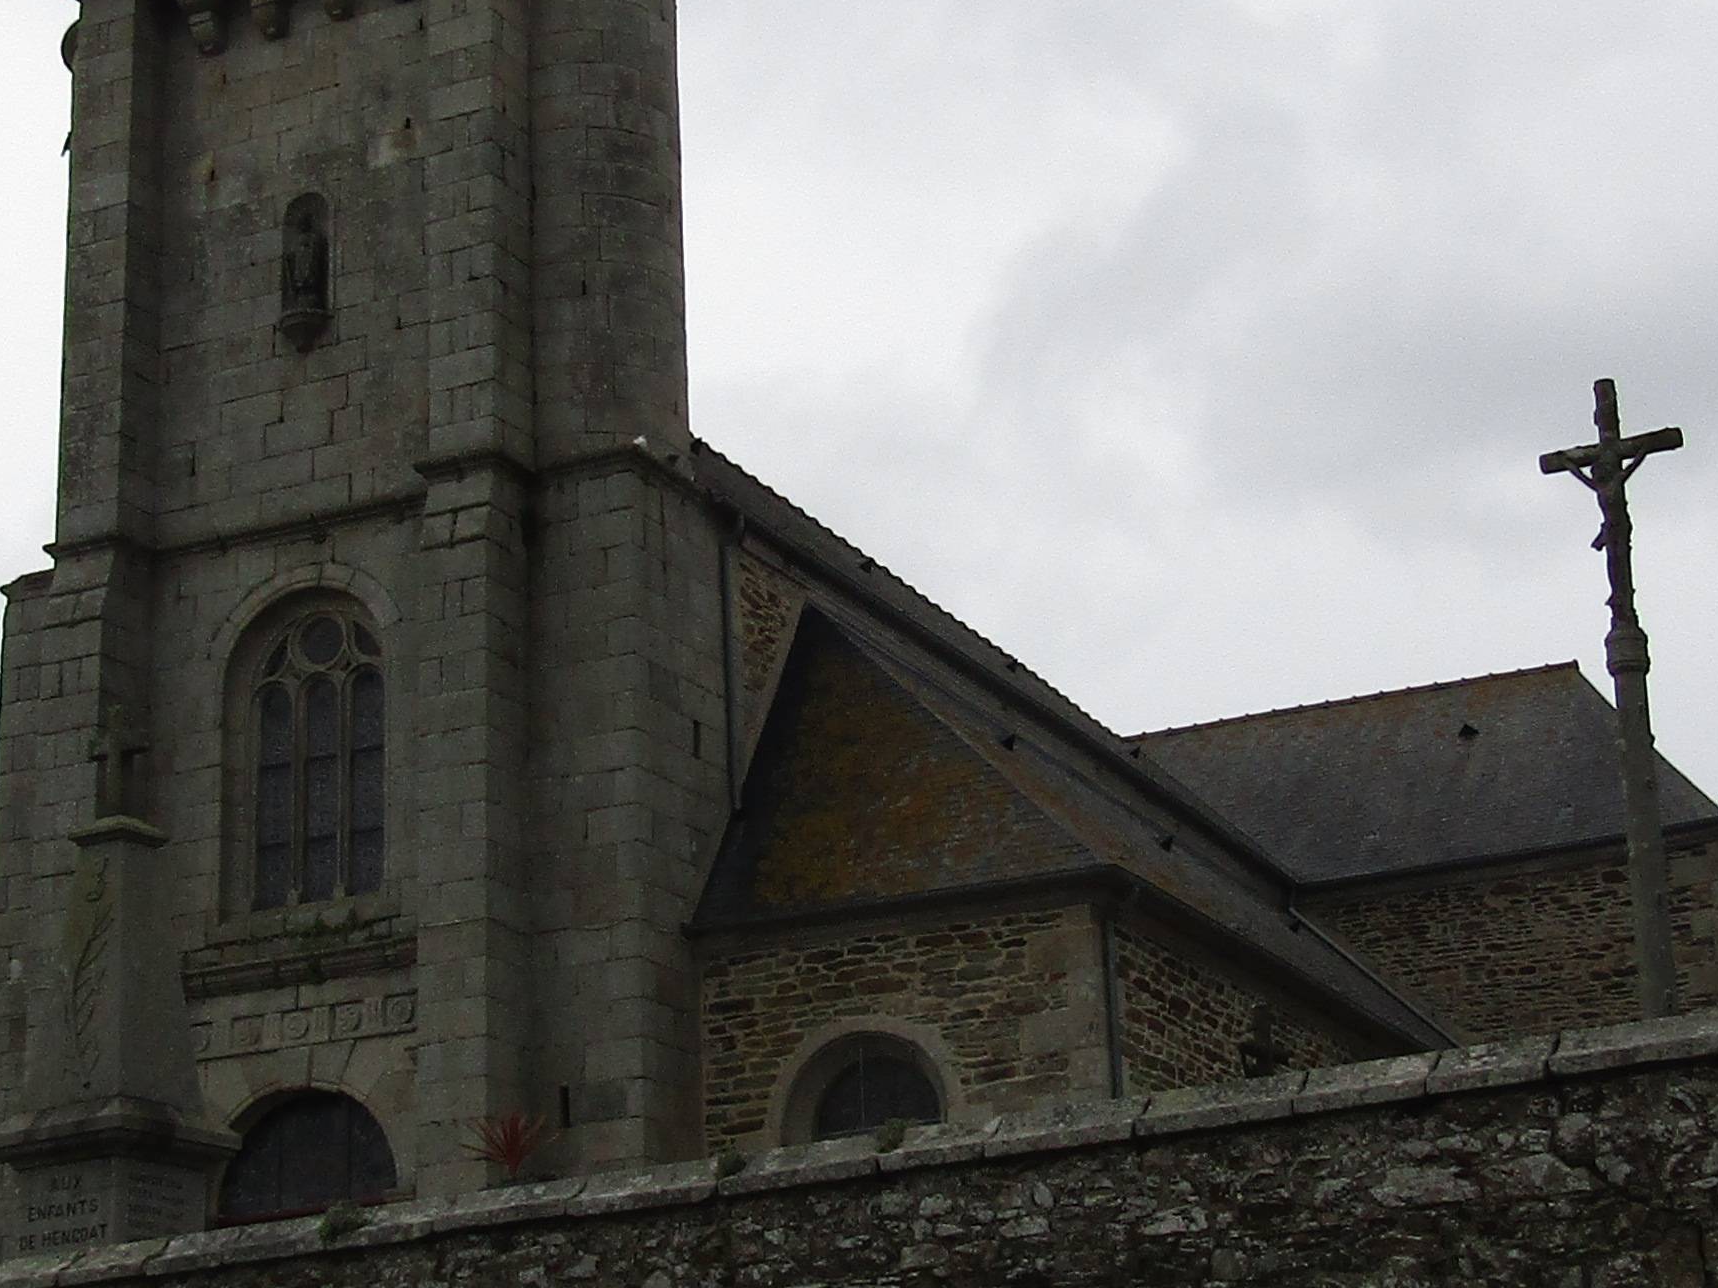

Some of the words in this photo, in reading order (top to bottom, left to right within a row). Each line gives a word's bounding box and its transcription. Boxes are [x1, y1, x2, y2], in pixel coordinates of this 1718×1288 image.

[50, 1175, 83, 1192] AUX
[27, 1198, 100, 1223] ENFANTS
[19, 1234, 36, 1251] DE
